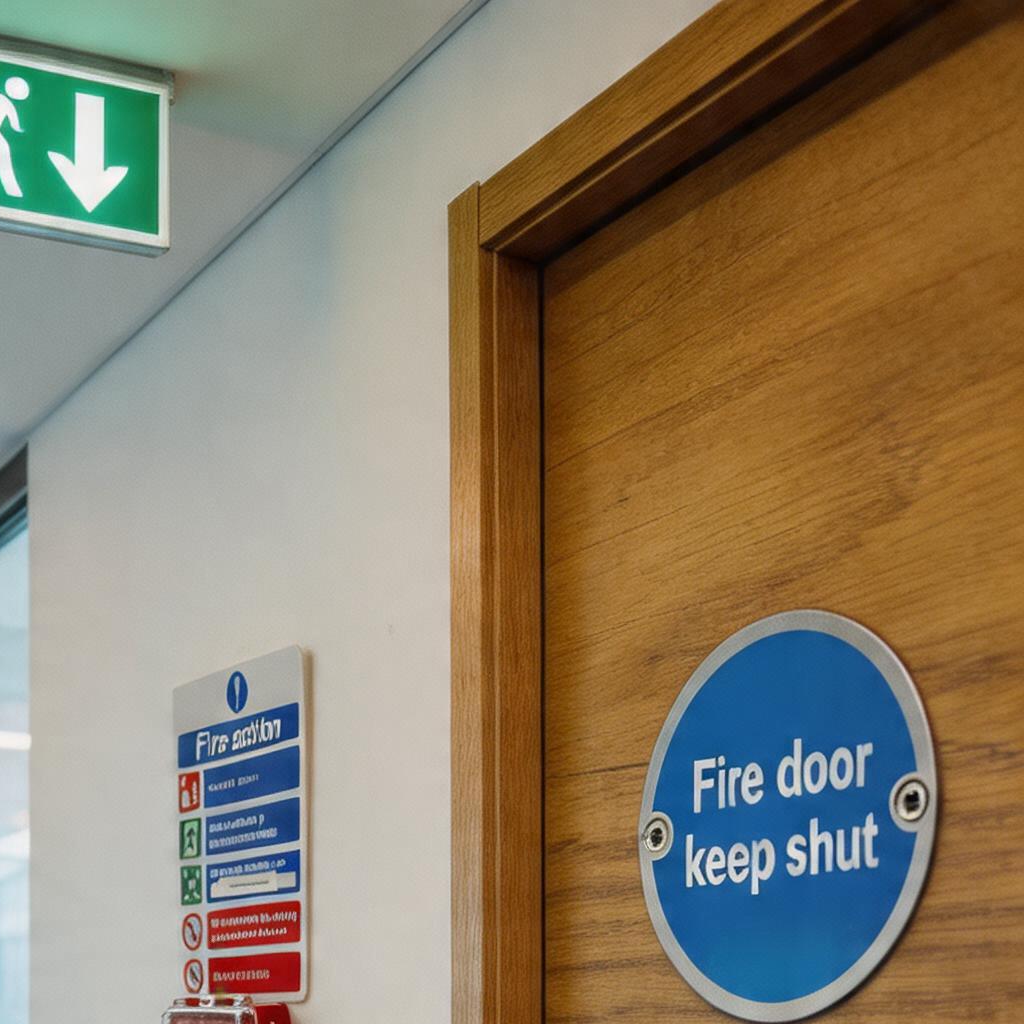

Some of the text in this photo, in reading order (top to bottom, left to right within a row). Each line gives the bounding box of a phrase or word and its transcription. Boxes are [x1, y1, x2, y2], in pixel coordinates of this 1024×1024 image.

[196, 731, 229, 761] Fire
[693, 737, 874, 814] Fire door
[685, 812, 880, 895] keep shut
